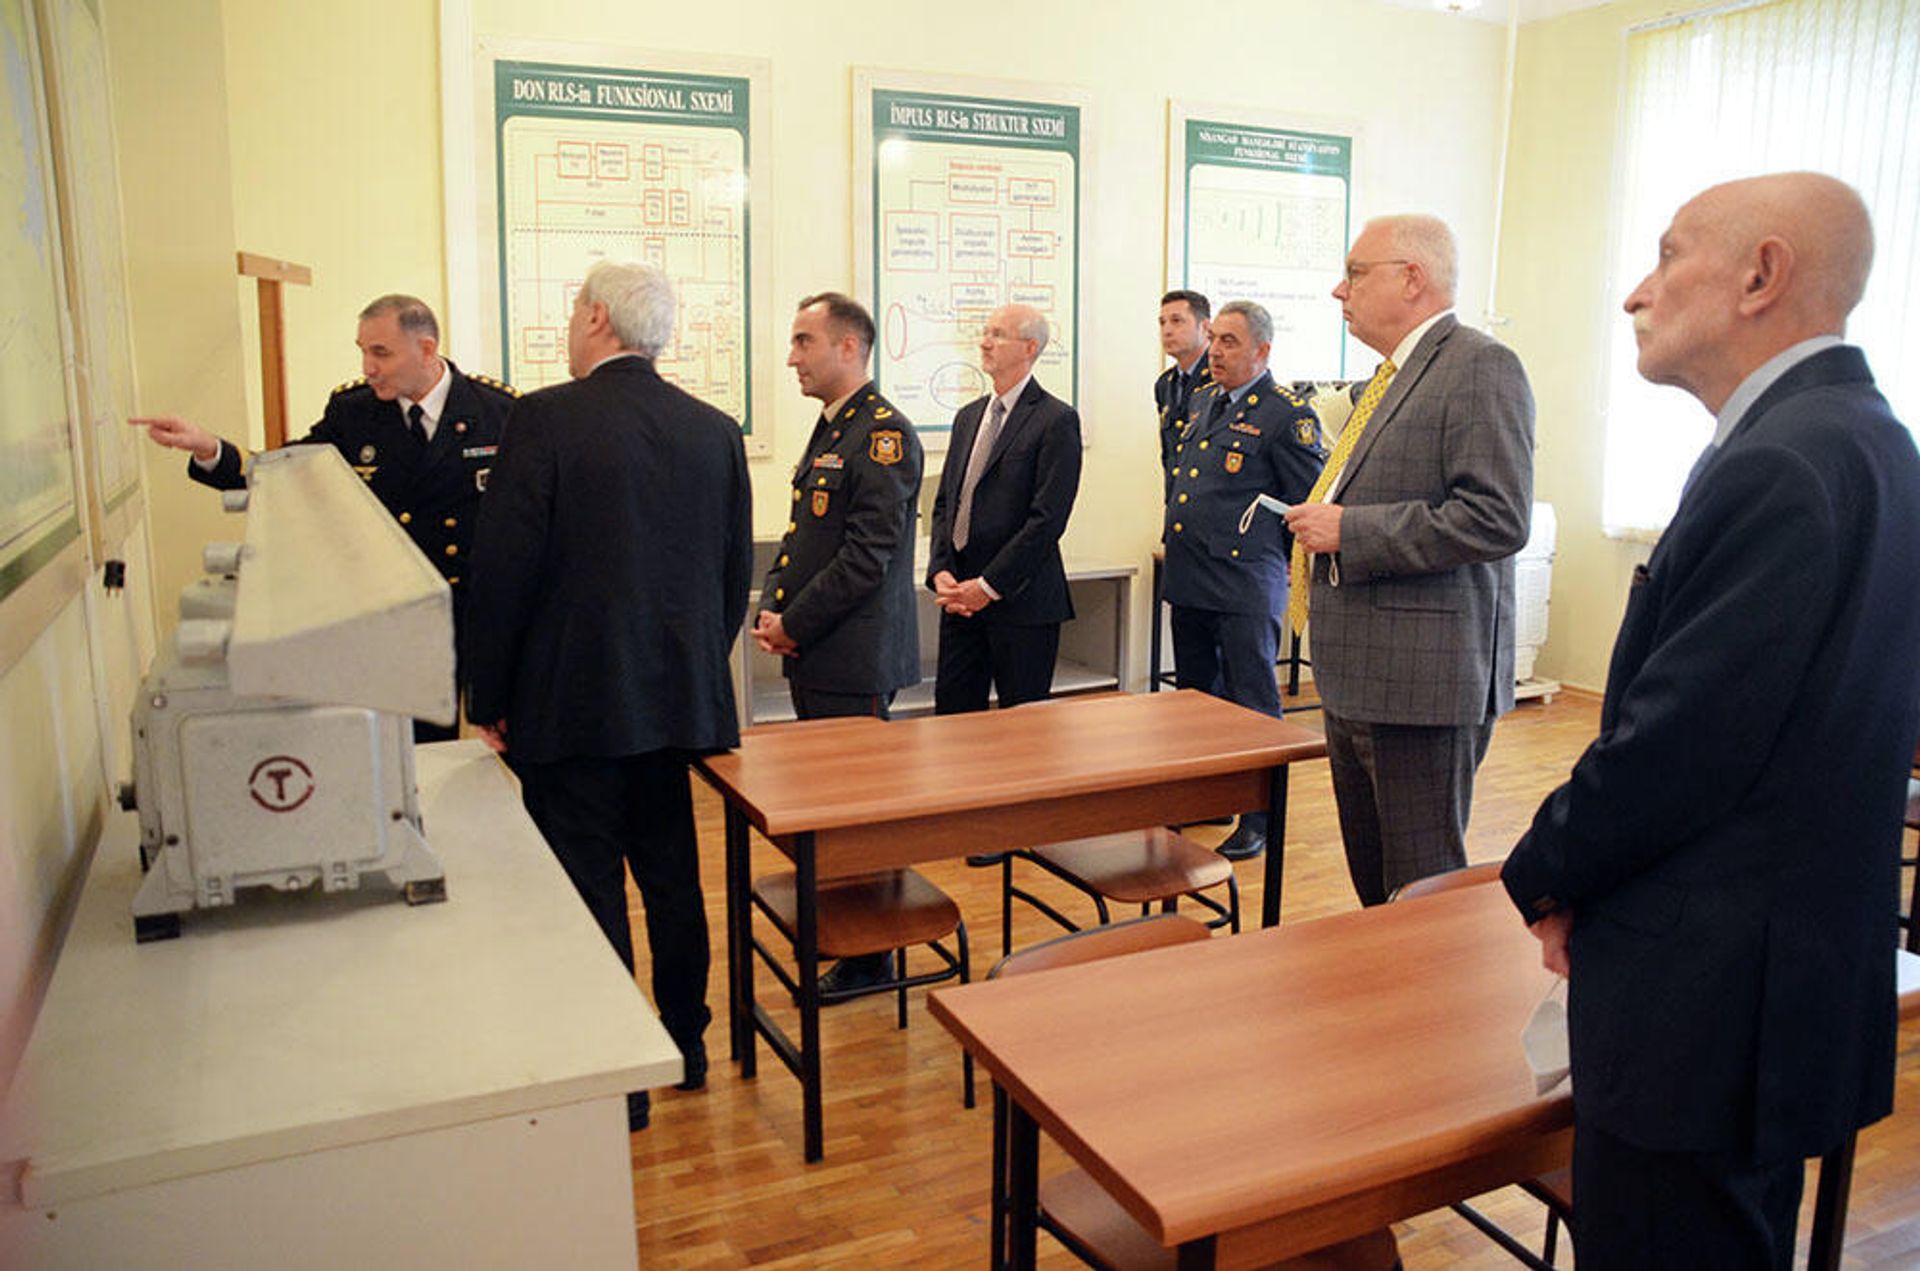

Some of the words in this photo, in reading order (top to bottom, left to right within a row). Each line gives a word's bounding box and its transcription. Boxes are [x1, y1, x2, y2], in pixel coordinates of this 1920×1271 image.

[513, 79, 545, 101] DON
[548, 81, 591, 104] RLS-in
[597, 83, 686, 111] FUNKSİONAL
[690, 89, 733, 113] SXEMİ
[890, 101, 932, 126] İMPULS
[936, 109, 969, 129] RLS-in
[972, 111, 1029, 134] STRUKTUR
[1031, 116, 1065, 138] SXEMİ
[267, 768, 292, 801] T
